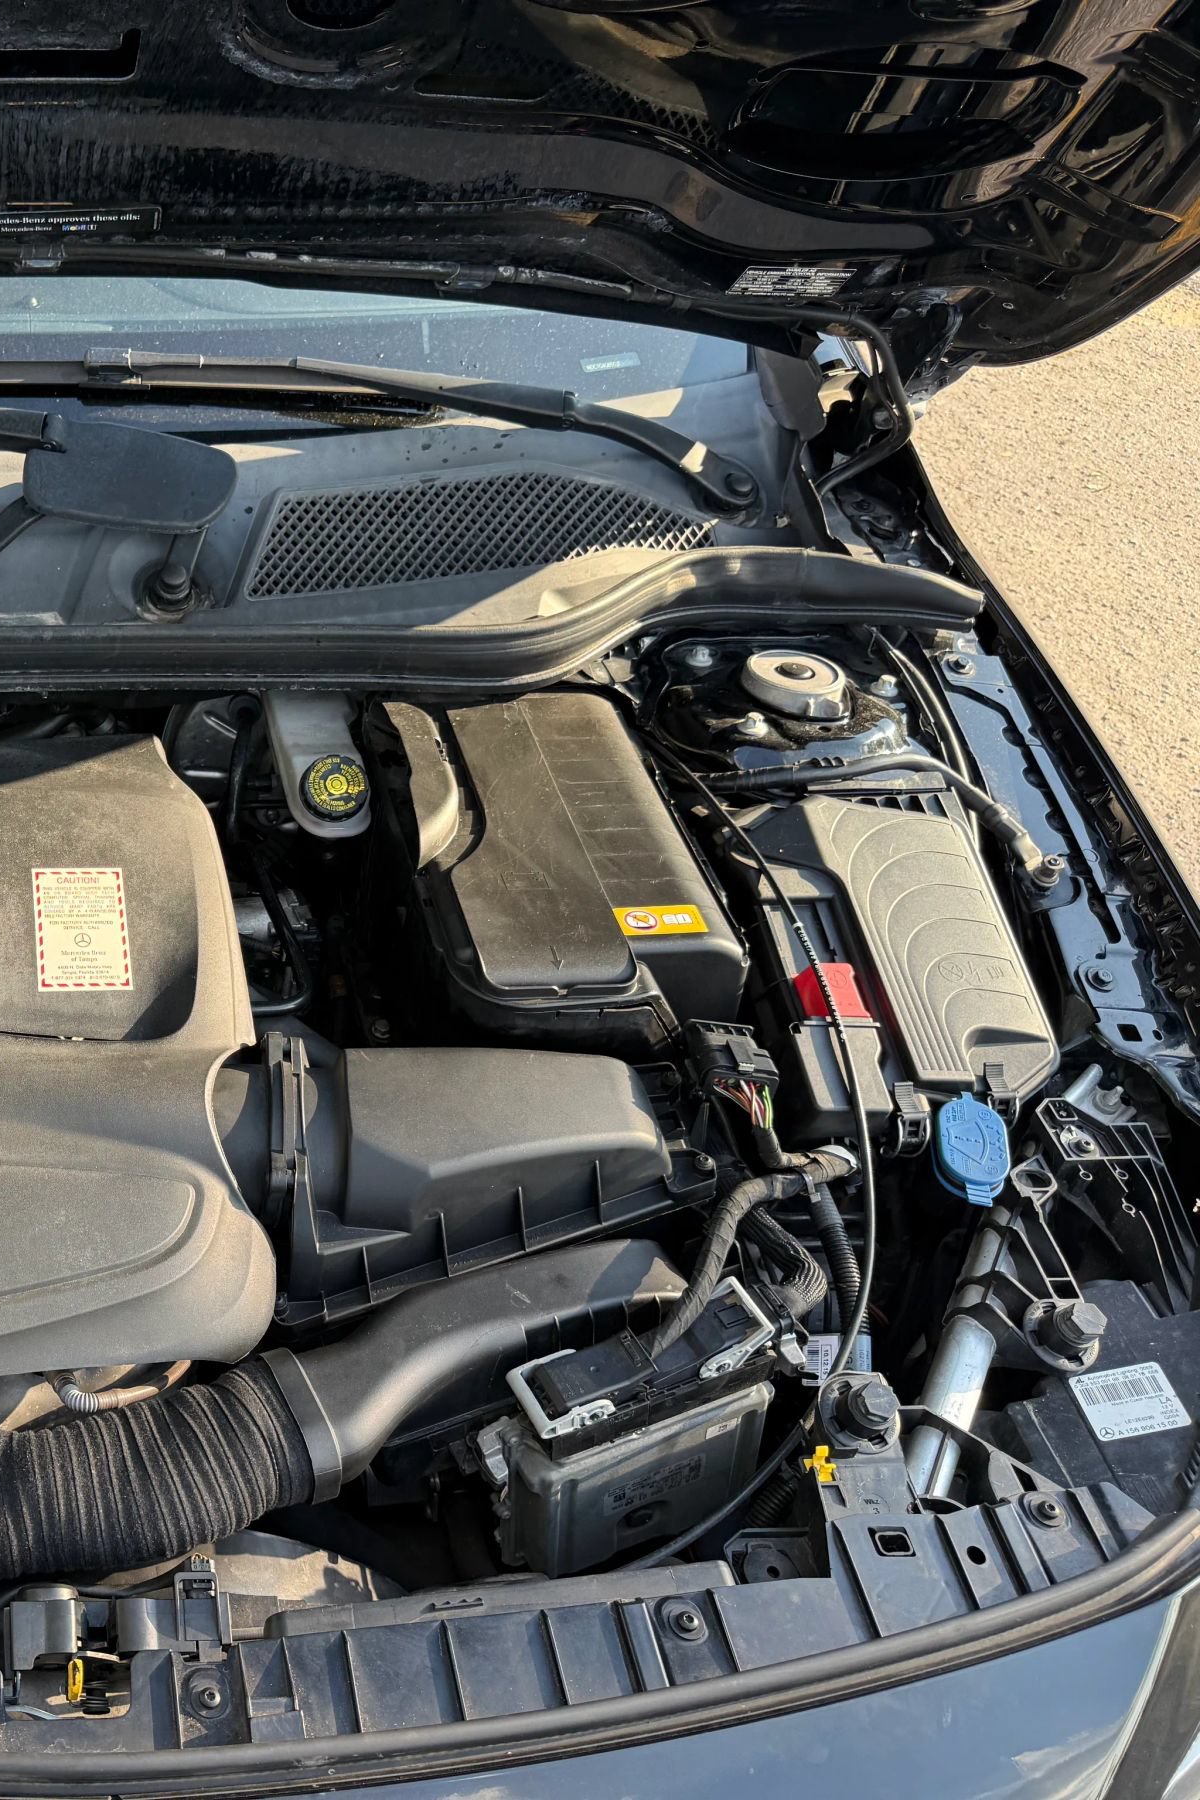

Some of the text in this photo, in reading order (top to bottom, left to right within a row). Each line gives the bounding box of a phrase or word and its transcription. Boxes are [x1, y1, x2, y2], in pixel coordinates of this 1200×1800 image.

[47, 216, 90, 225] approves
[92, 214, 118, 222] these
[873, 1507, 880, 1515] 3
